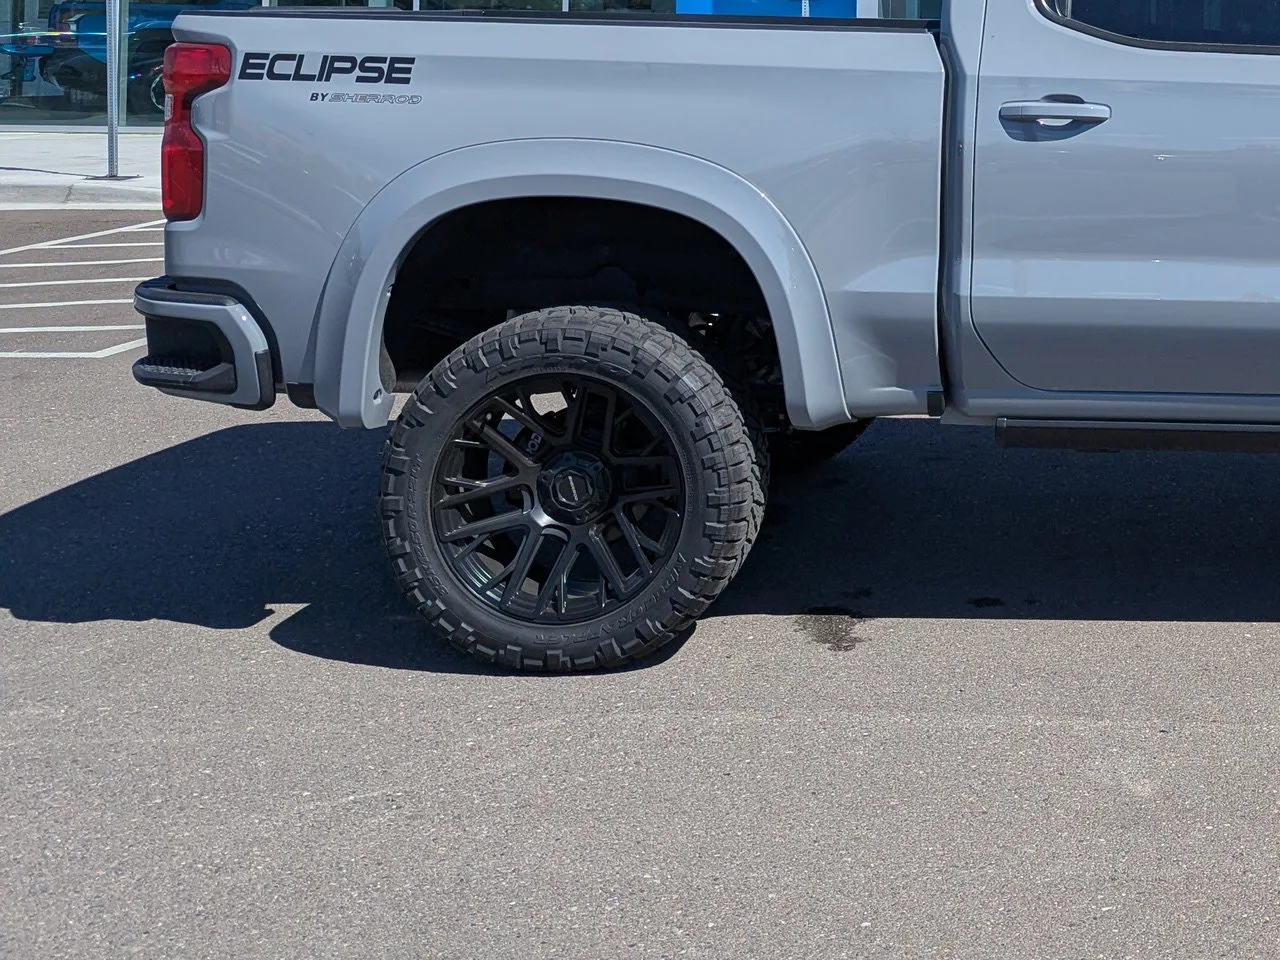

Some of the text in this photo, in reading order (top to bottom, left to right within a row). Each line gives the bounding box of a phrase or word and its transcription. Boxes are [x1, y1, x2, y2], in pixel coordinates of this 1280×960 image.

[237, 52, 417, 85] ECLIPSE
[309, 92, 423, 105] BY SHERROD
